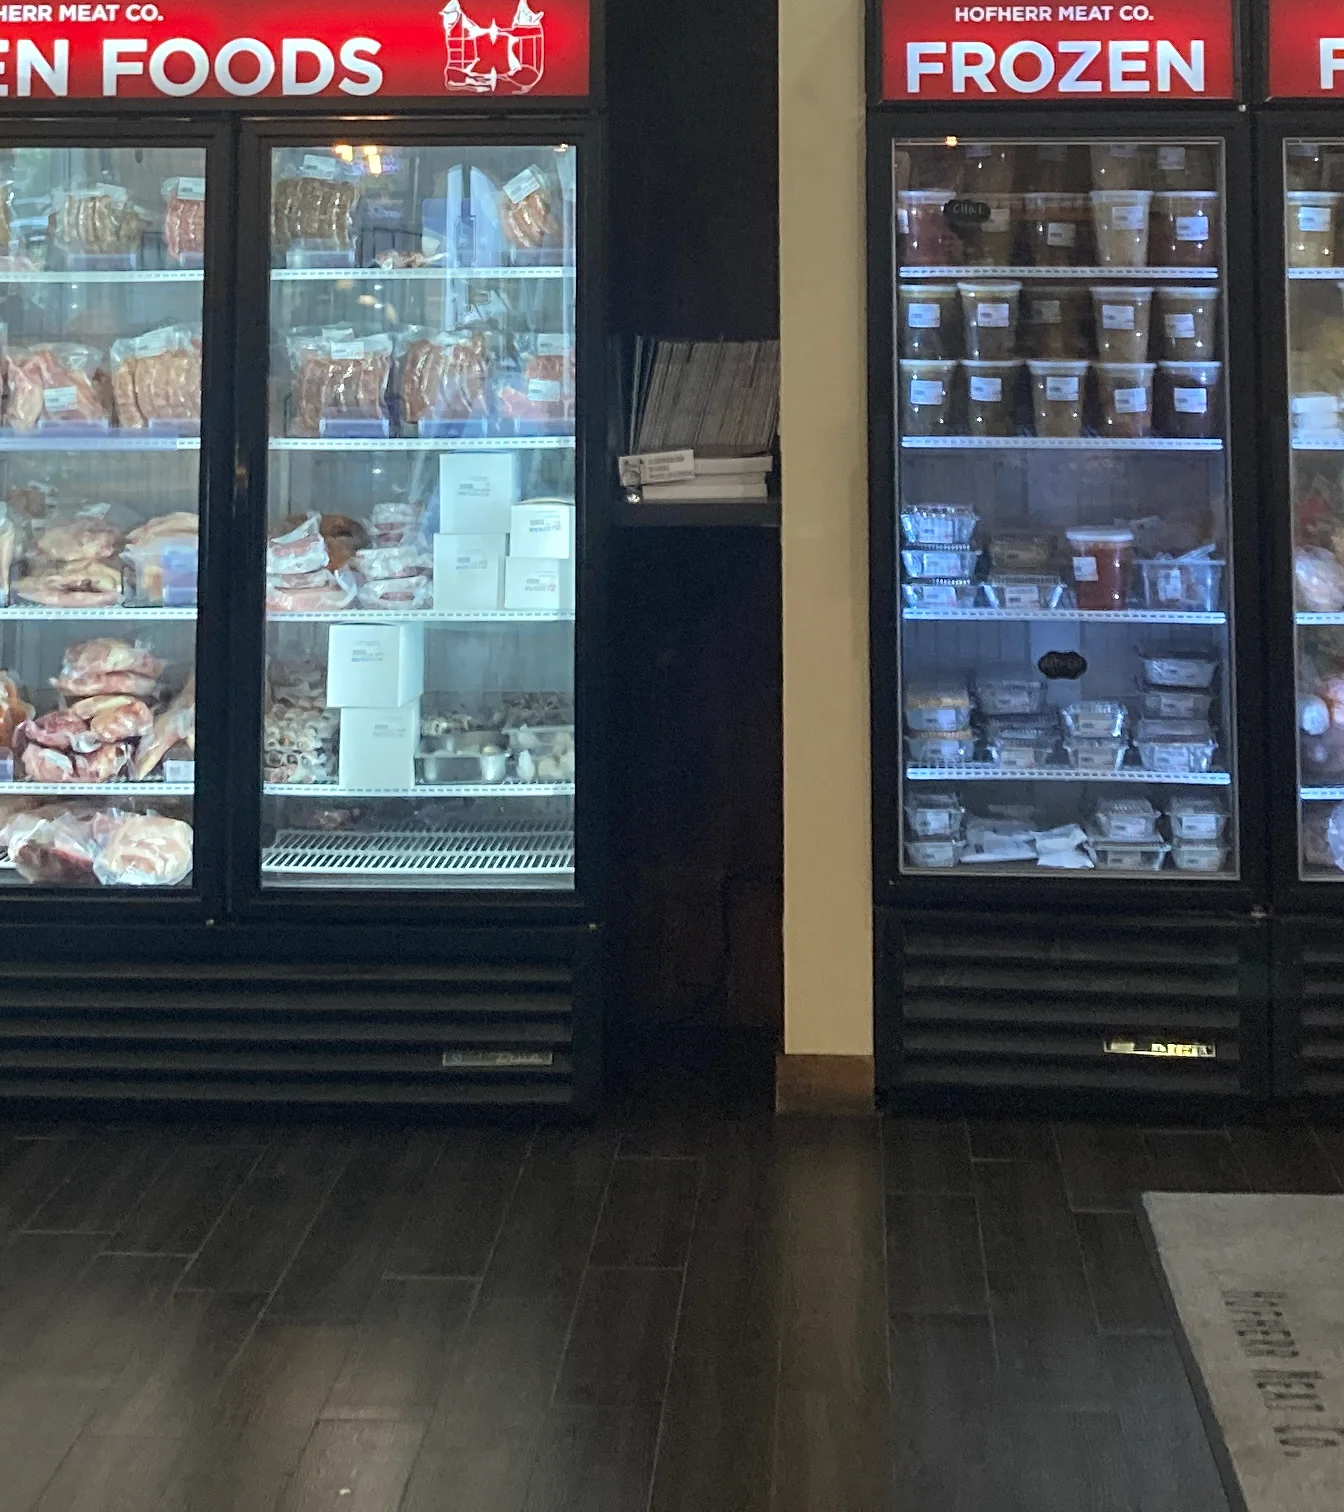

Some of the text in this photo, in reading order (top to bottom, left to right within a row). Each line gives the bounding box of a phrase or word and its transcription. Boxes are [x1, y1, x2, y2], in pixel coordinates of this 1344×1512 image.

[58, 4, 119, 22] MEAT
[125, 4, 164, 22] CO.
[954, 4, 1154, 22] HOFHERR MEAT CO.
[102, 36, 384, 97] FOODS
[905, 39, 1205, 94] FROZEN
